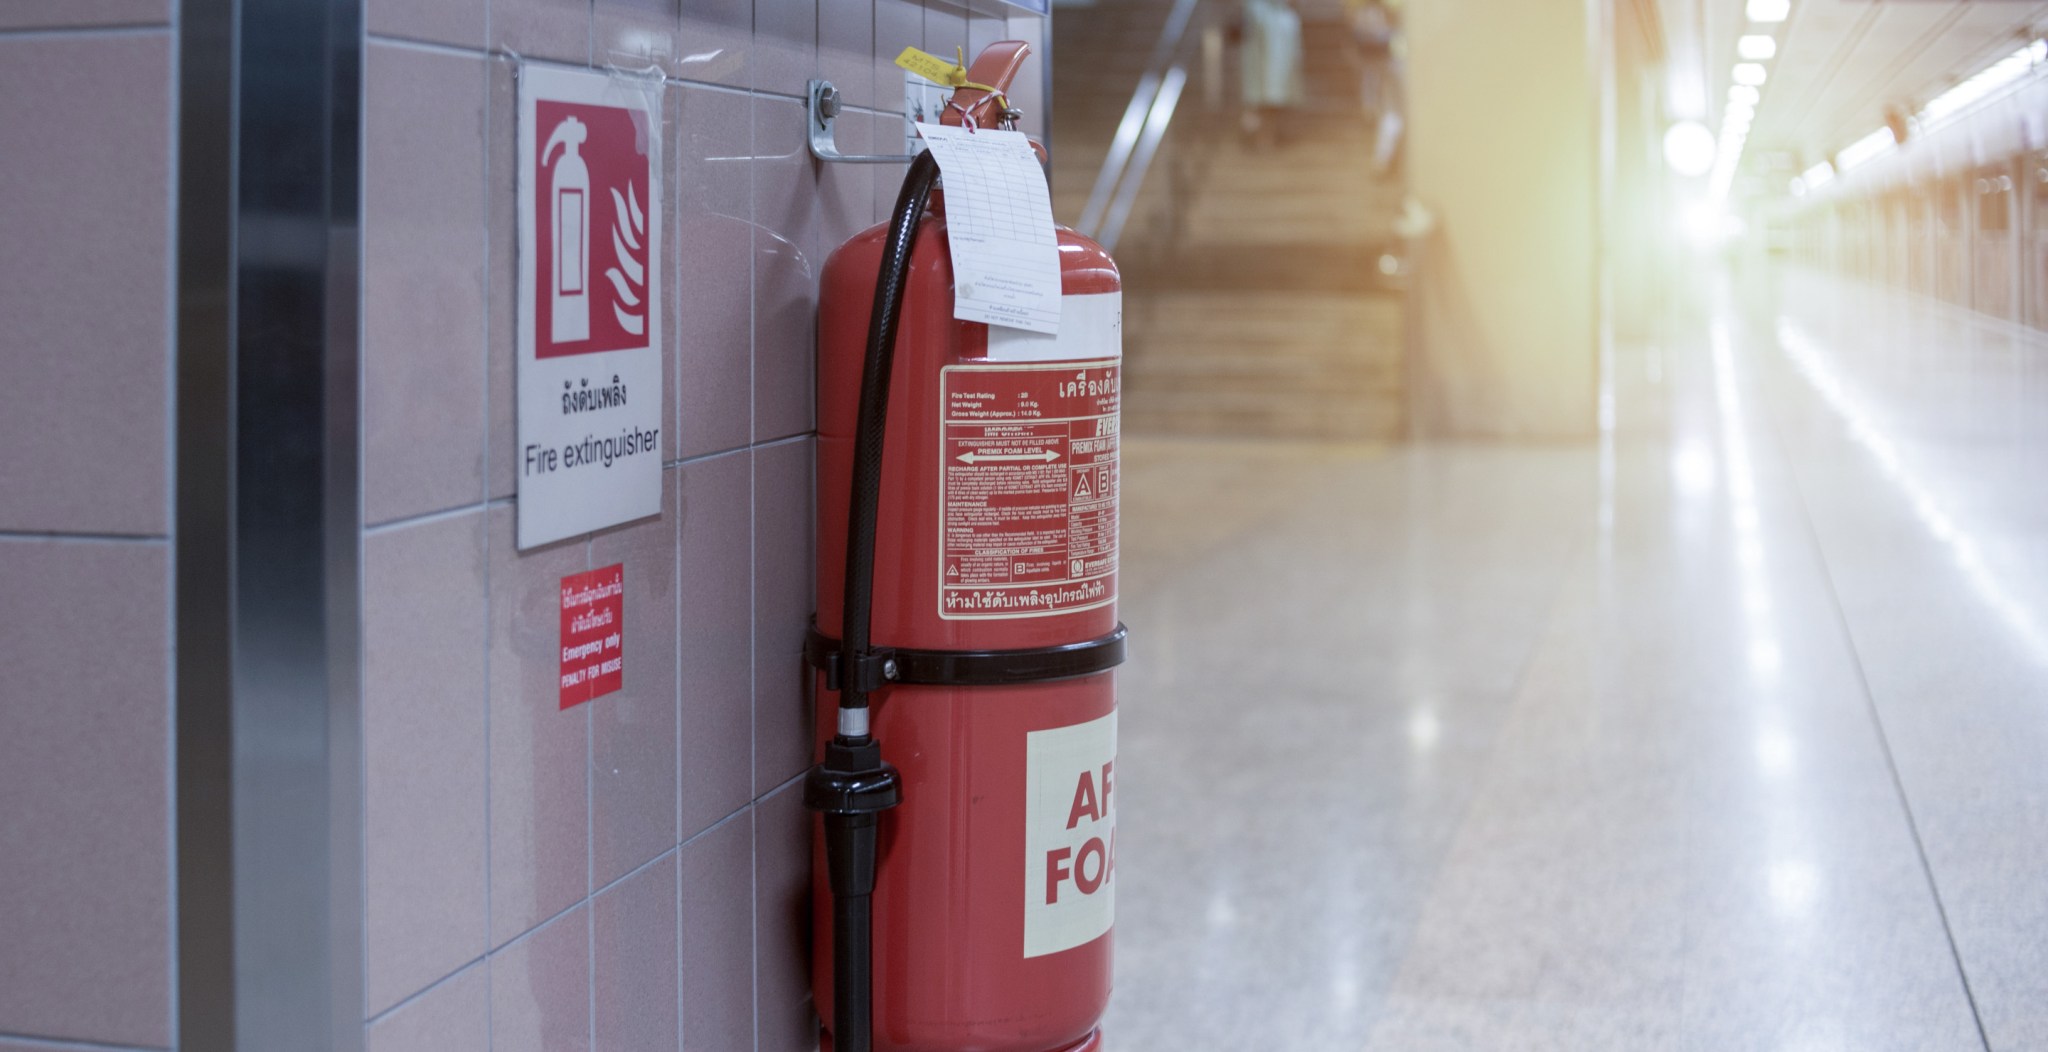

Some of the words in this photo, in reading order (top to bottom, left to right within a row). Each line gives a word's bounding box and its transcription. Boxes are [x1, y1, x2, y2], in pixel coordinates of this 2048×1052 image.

[562, 374, 626, 415] ถังดับเพลิง
[526, 444, 558, 476] Fire
[564, 426, 659, 468] extinguisher
[1072, 441, 1093, 455] PREMIX
[946, 580, 1105, 609] ห้ามใช้ดับเพลิงอุปกรณ์ไฟฟ้า
[562, 640, 602, 662] Emergency
[605, 632, 620, 648] only
[562, 668, 586, 688] PENALTY
[588, 664, 600, 680] FOR
[601, 656, 622, 675] MISUSE
